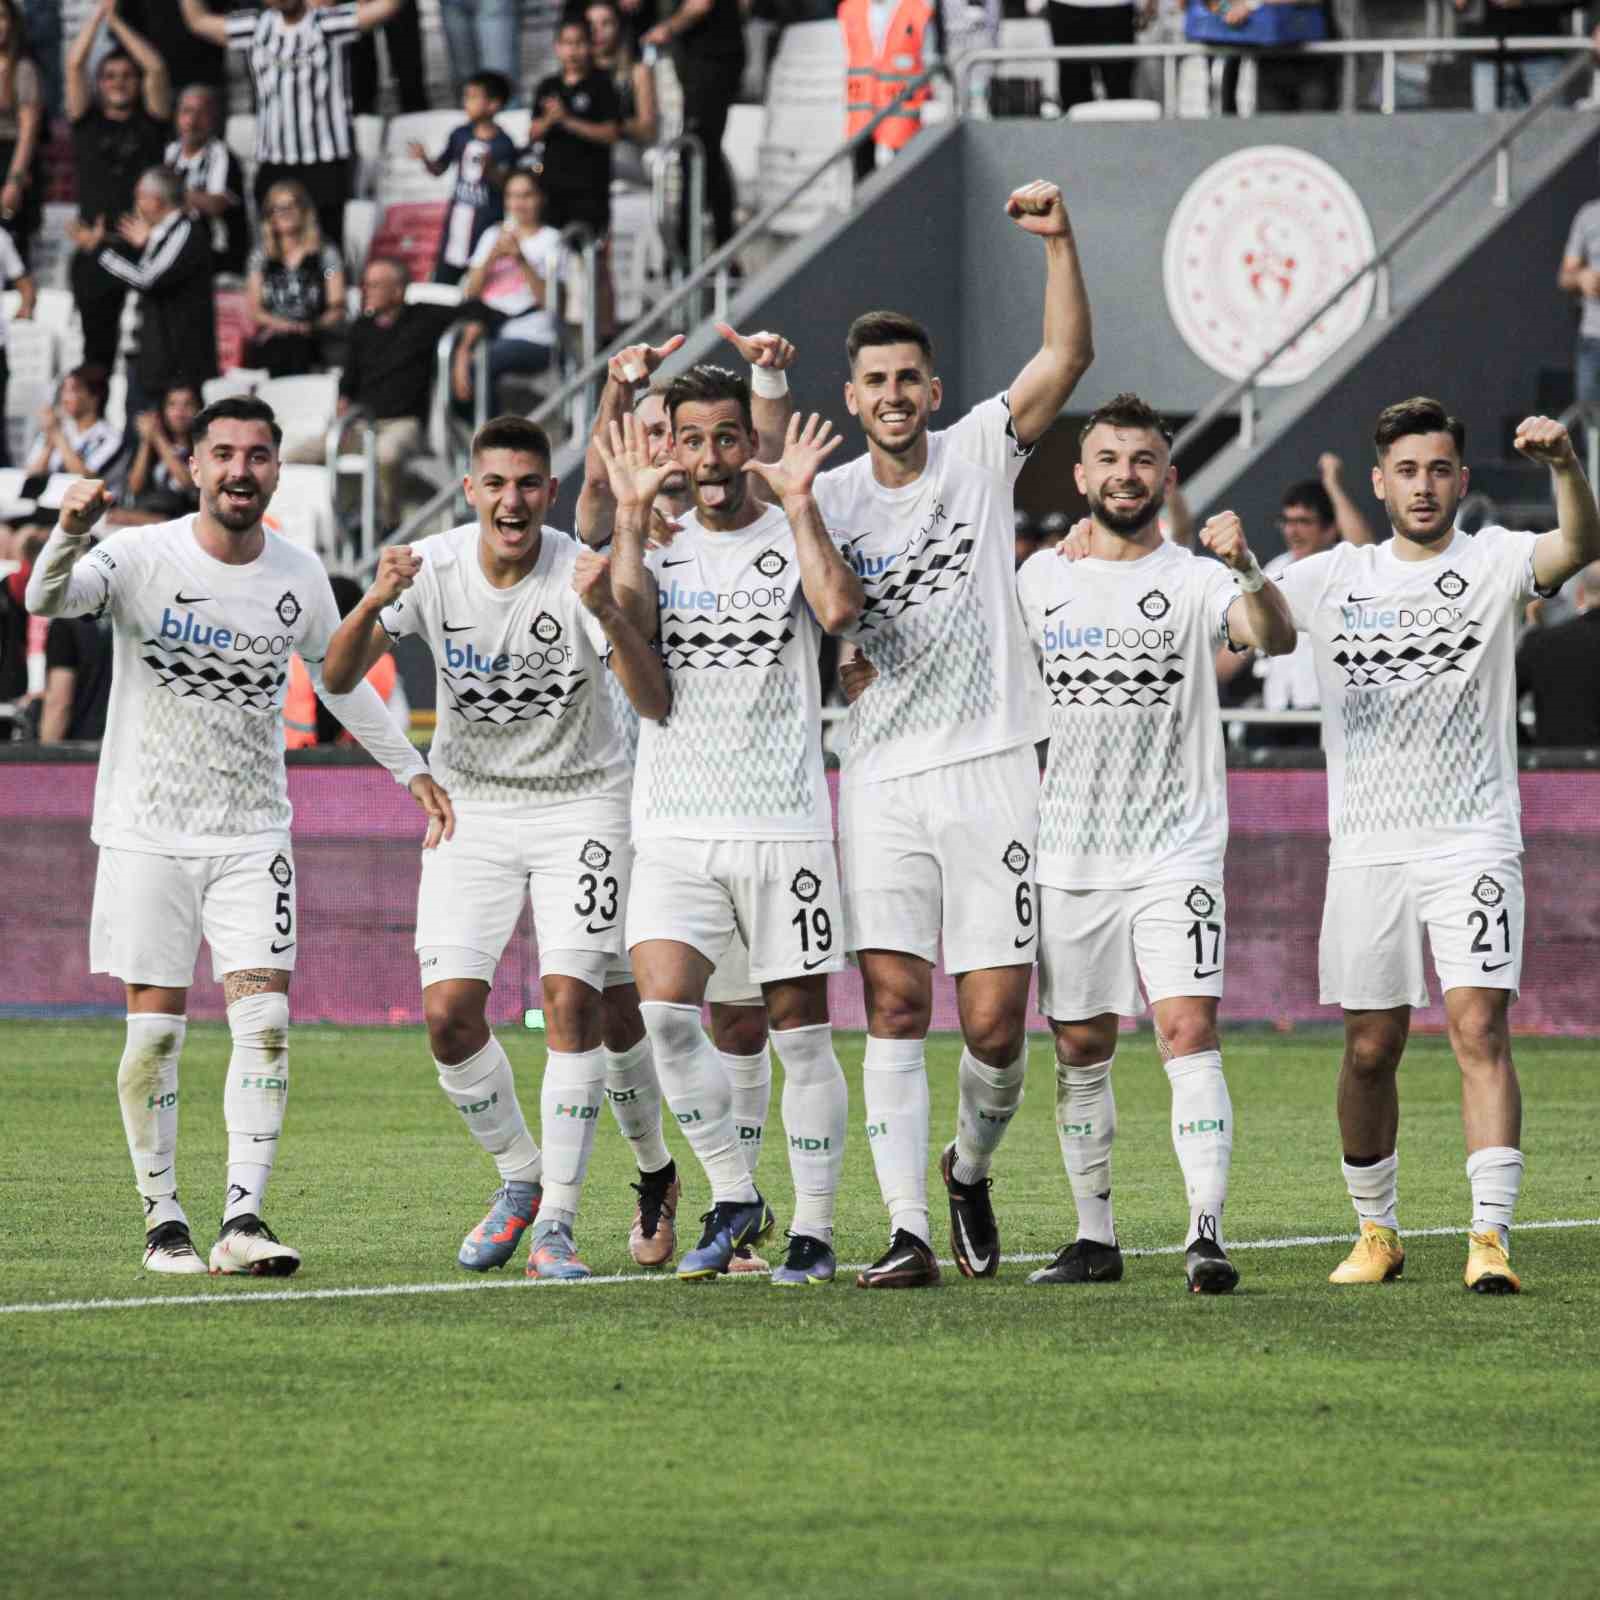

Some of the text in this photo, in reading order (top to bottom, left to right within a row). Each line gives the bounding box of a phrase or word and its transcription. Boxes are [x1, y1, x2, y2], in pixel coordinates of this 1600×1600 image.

[574, 873, 618, 921] 33
[1015, 881, 1032, 927] 6
[275, 892, 291, 936] 5
[792, 907, 832, 952] 19
[1467, 909, 1510, 953] 21
[1187, 921, 1221, 965] 17
[241, 1077, 287, 1091] HDI
[147, 1092, 177, 1109] HD
[555, 1103, 599, 1119] HDI
[673, 1109, 701, 1123] DI
[735, 1125, 762, 1140] DI
[1179, 1119, 1224, 1135] HDI
[790, 1136, 830, 1150] HDI
